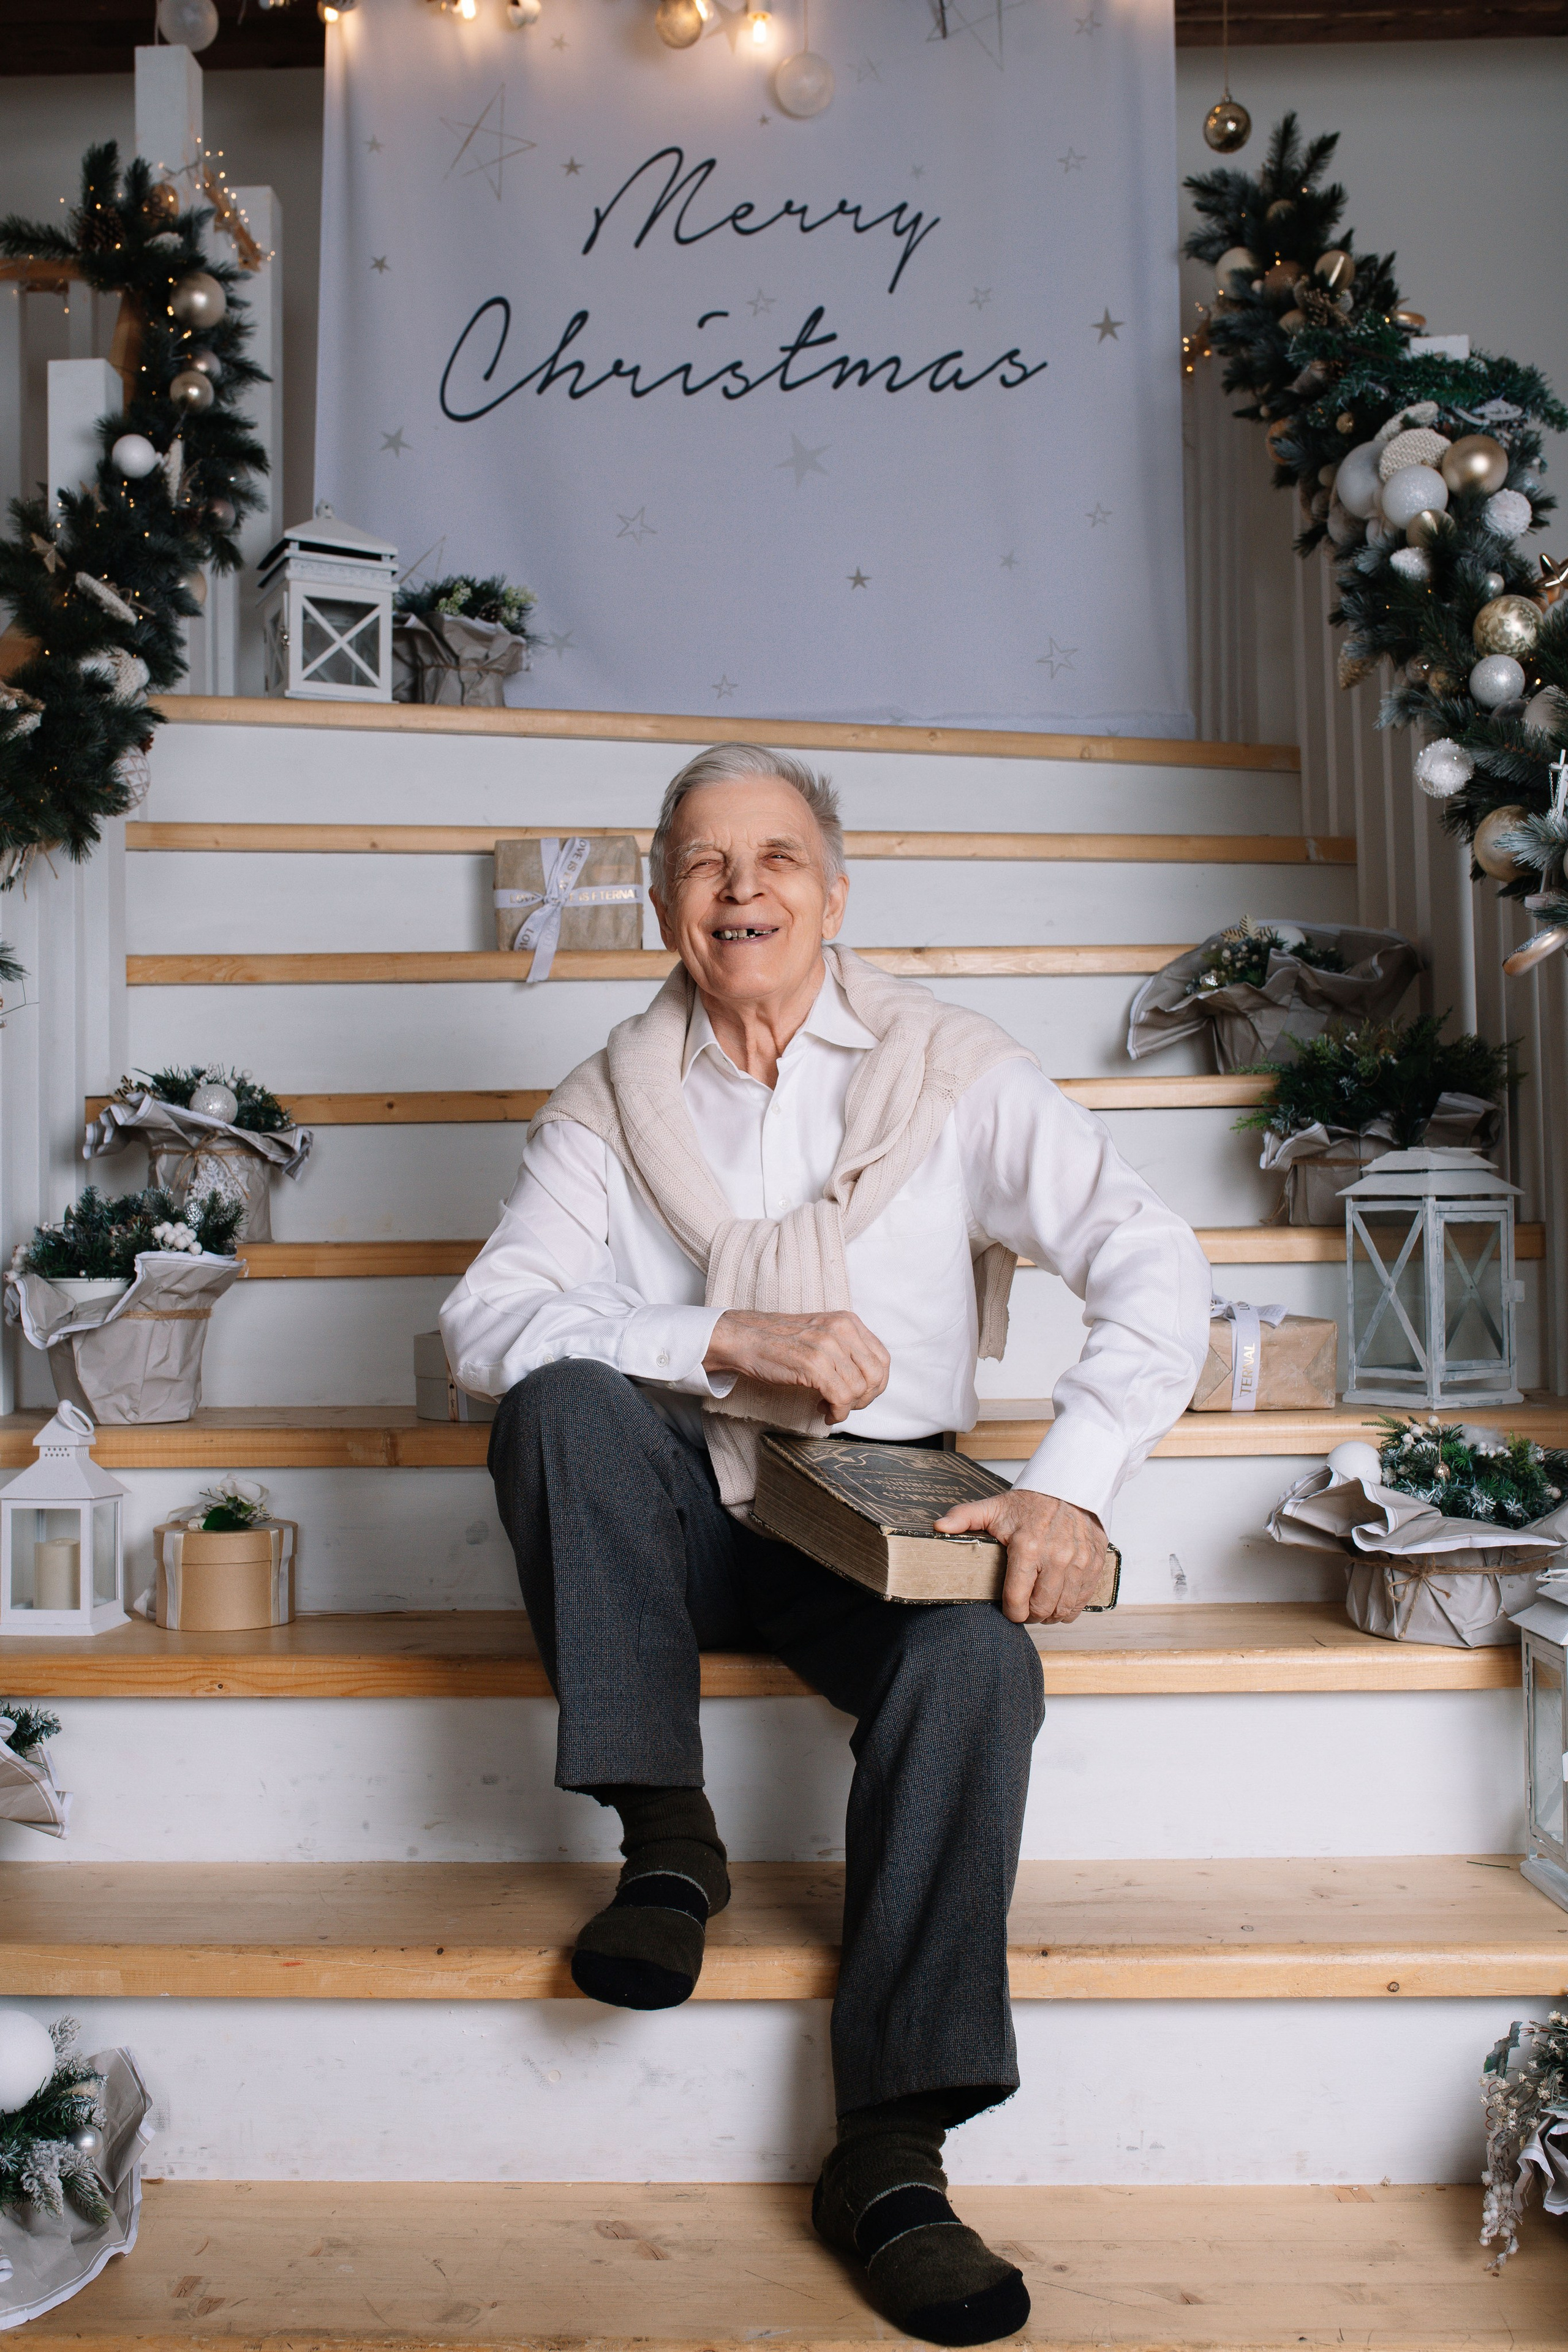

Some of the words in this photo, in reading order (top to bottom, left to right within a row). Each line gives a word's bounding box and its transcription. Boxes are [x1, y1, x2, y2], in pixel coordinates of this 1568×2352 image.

[582, 146, 941, 294] Merry
[439, 296, 1048, 423] Christmas
[573, 839, 586, 860] OVE
[1239, 1343, 1255, 1396] TERNAL
[882, 1491, 979, 1504] TRONG'S
